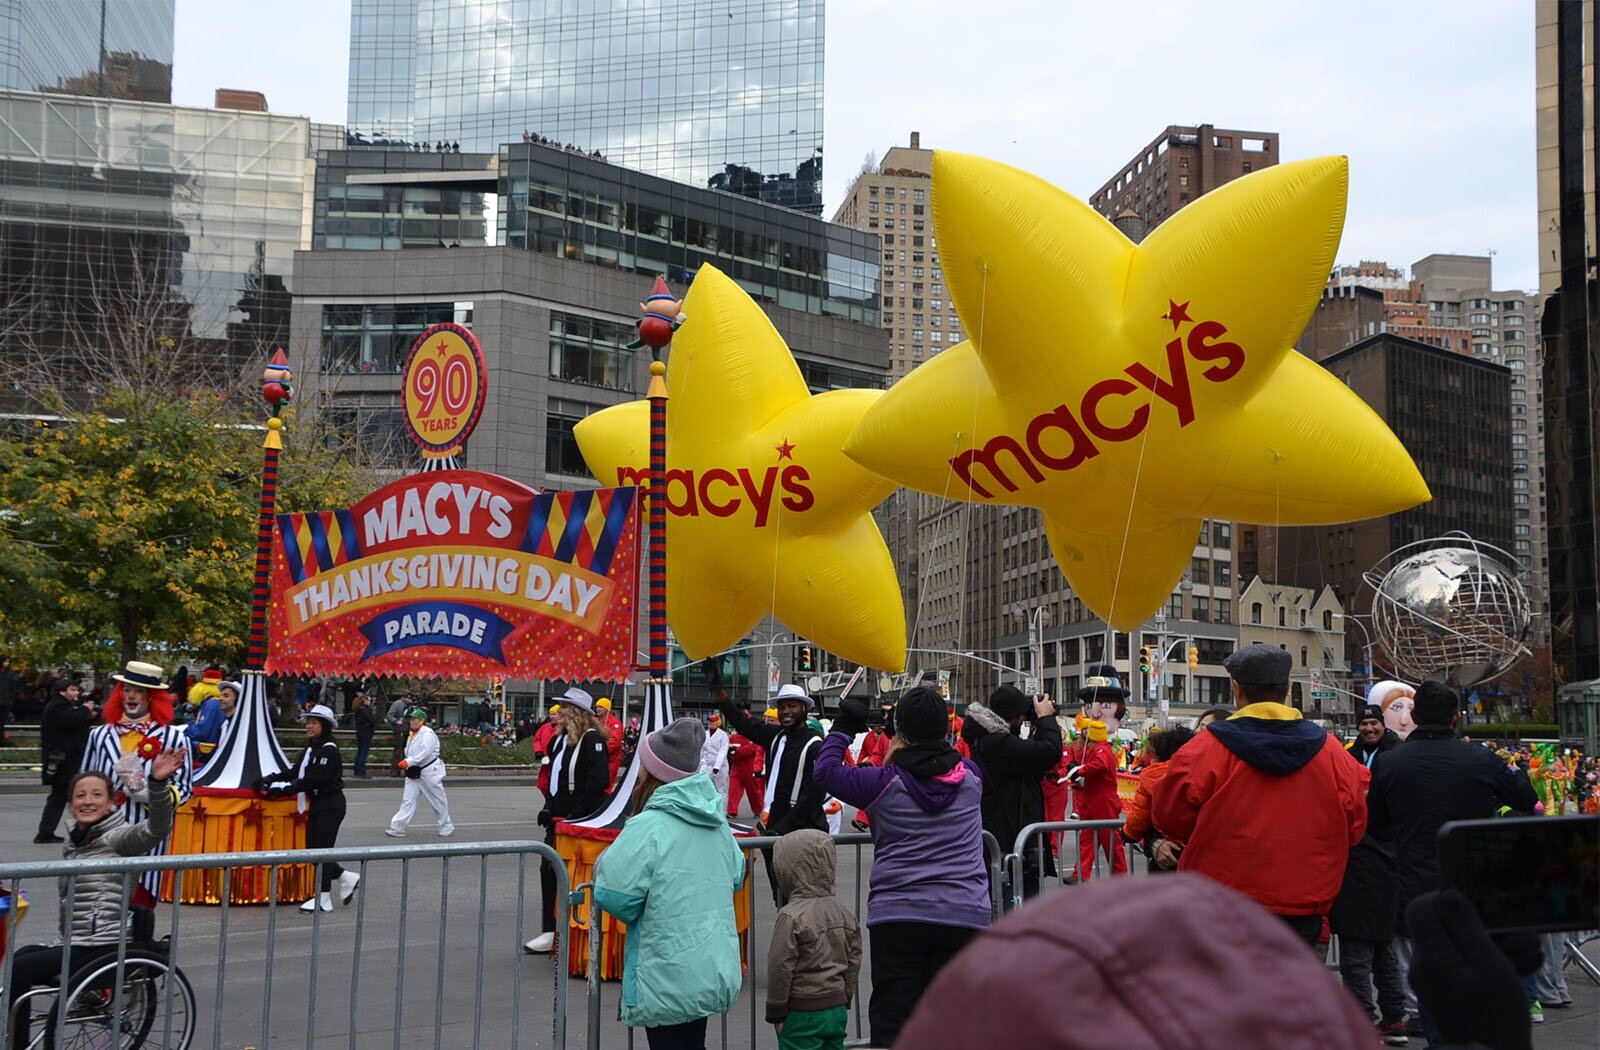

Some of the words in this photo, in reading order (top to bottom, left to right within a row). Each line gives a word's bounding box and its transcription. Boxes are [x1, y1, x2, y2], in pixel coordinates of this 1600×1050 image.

[413, 353, 472, 419] 90
[422, 416, 458, 432] YEARS
[363, 481, 513, 548] MACY'S
[293, 553, 518, 622] THANKSGIVING
[525, 566, 602, 618] DAY
[384, 611, 487, 645] PARADE
[1027, 686, 1037, 694] 25
